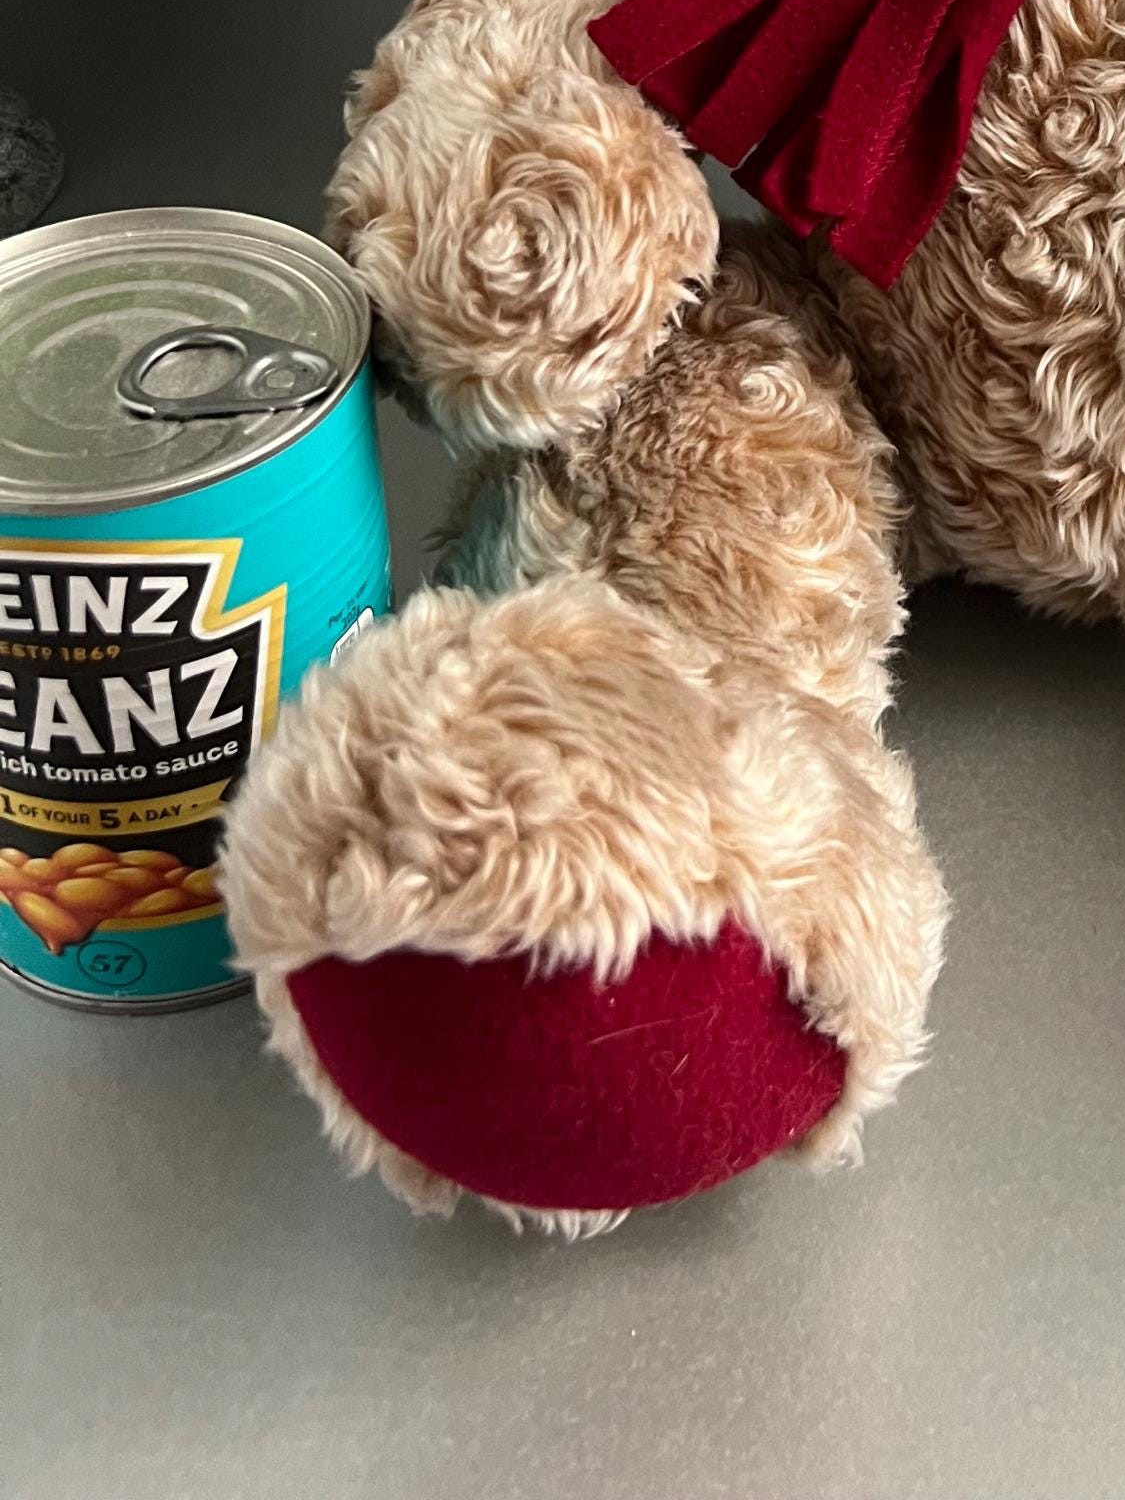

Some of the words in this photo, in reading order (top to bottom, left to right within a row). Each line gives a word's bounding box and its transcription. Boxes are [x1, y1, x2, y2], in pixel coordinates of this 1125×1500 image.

[0, 572, 189, 634] EINZ
[61, 644, 120, 662] 1869
[0, 647, 243, 754] EANZ
[0, 750, 37, 777] ich
[42, 762, 148, 782] tomato
[156, 740, 239, 776] sauce
[18, 804, 38, 818] OF
[43, 809, 91, 825] YOUR
[100, 808, 121, 829] 5
[128, 811, 142, 823] A
[145, 803, 182, 821] DAY
[89, 954, 133, 975] 57
